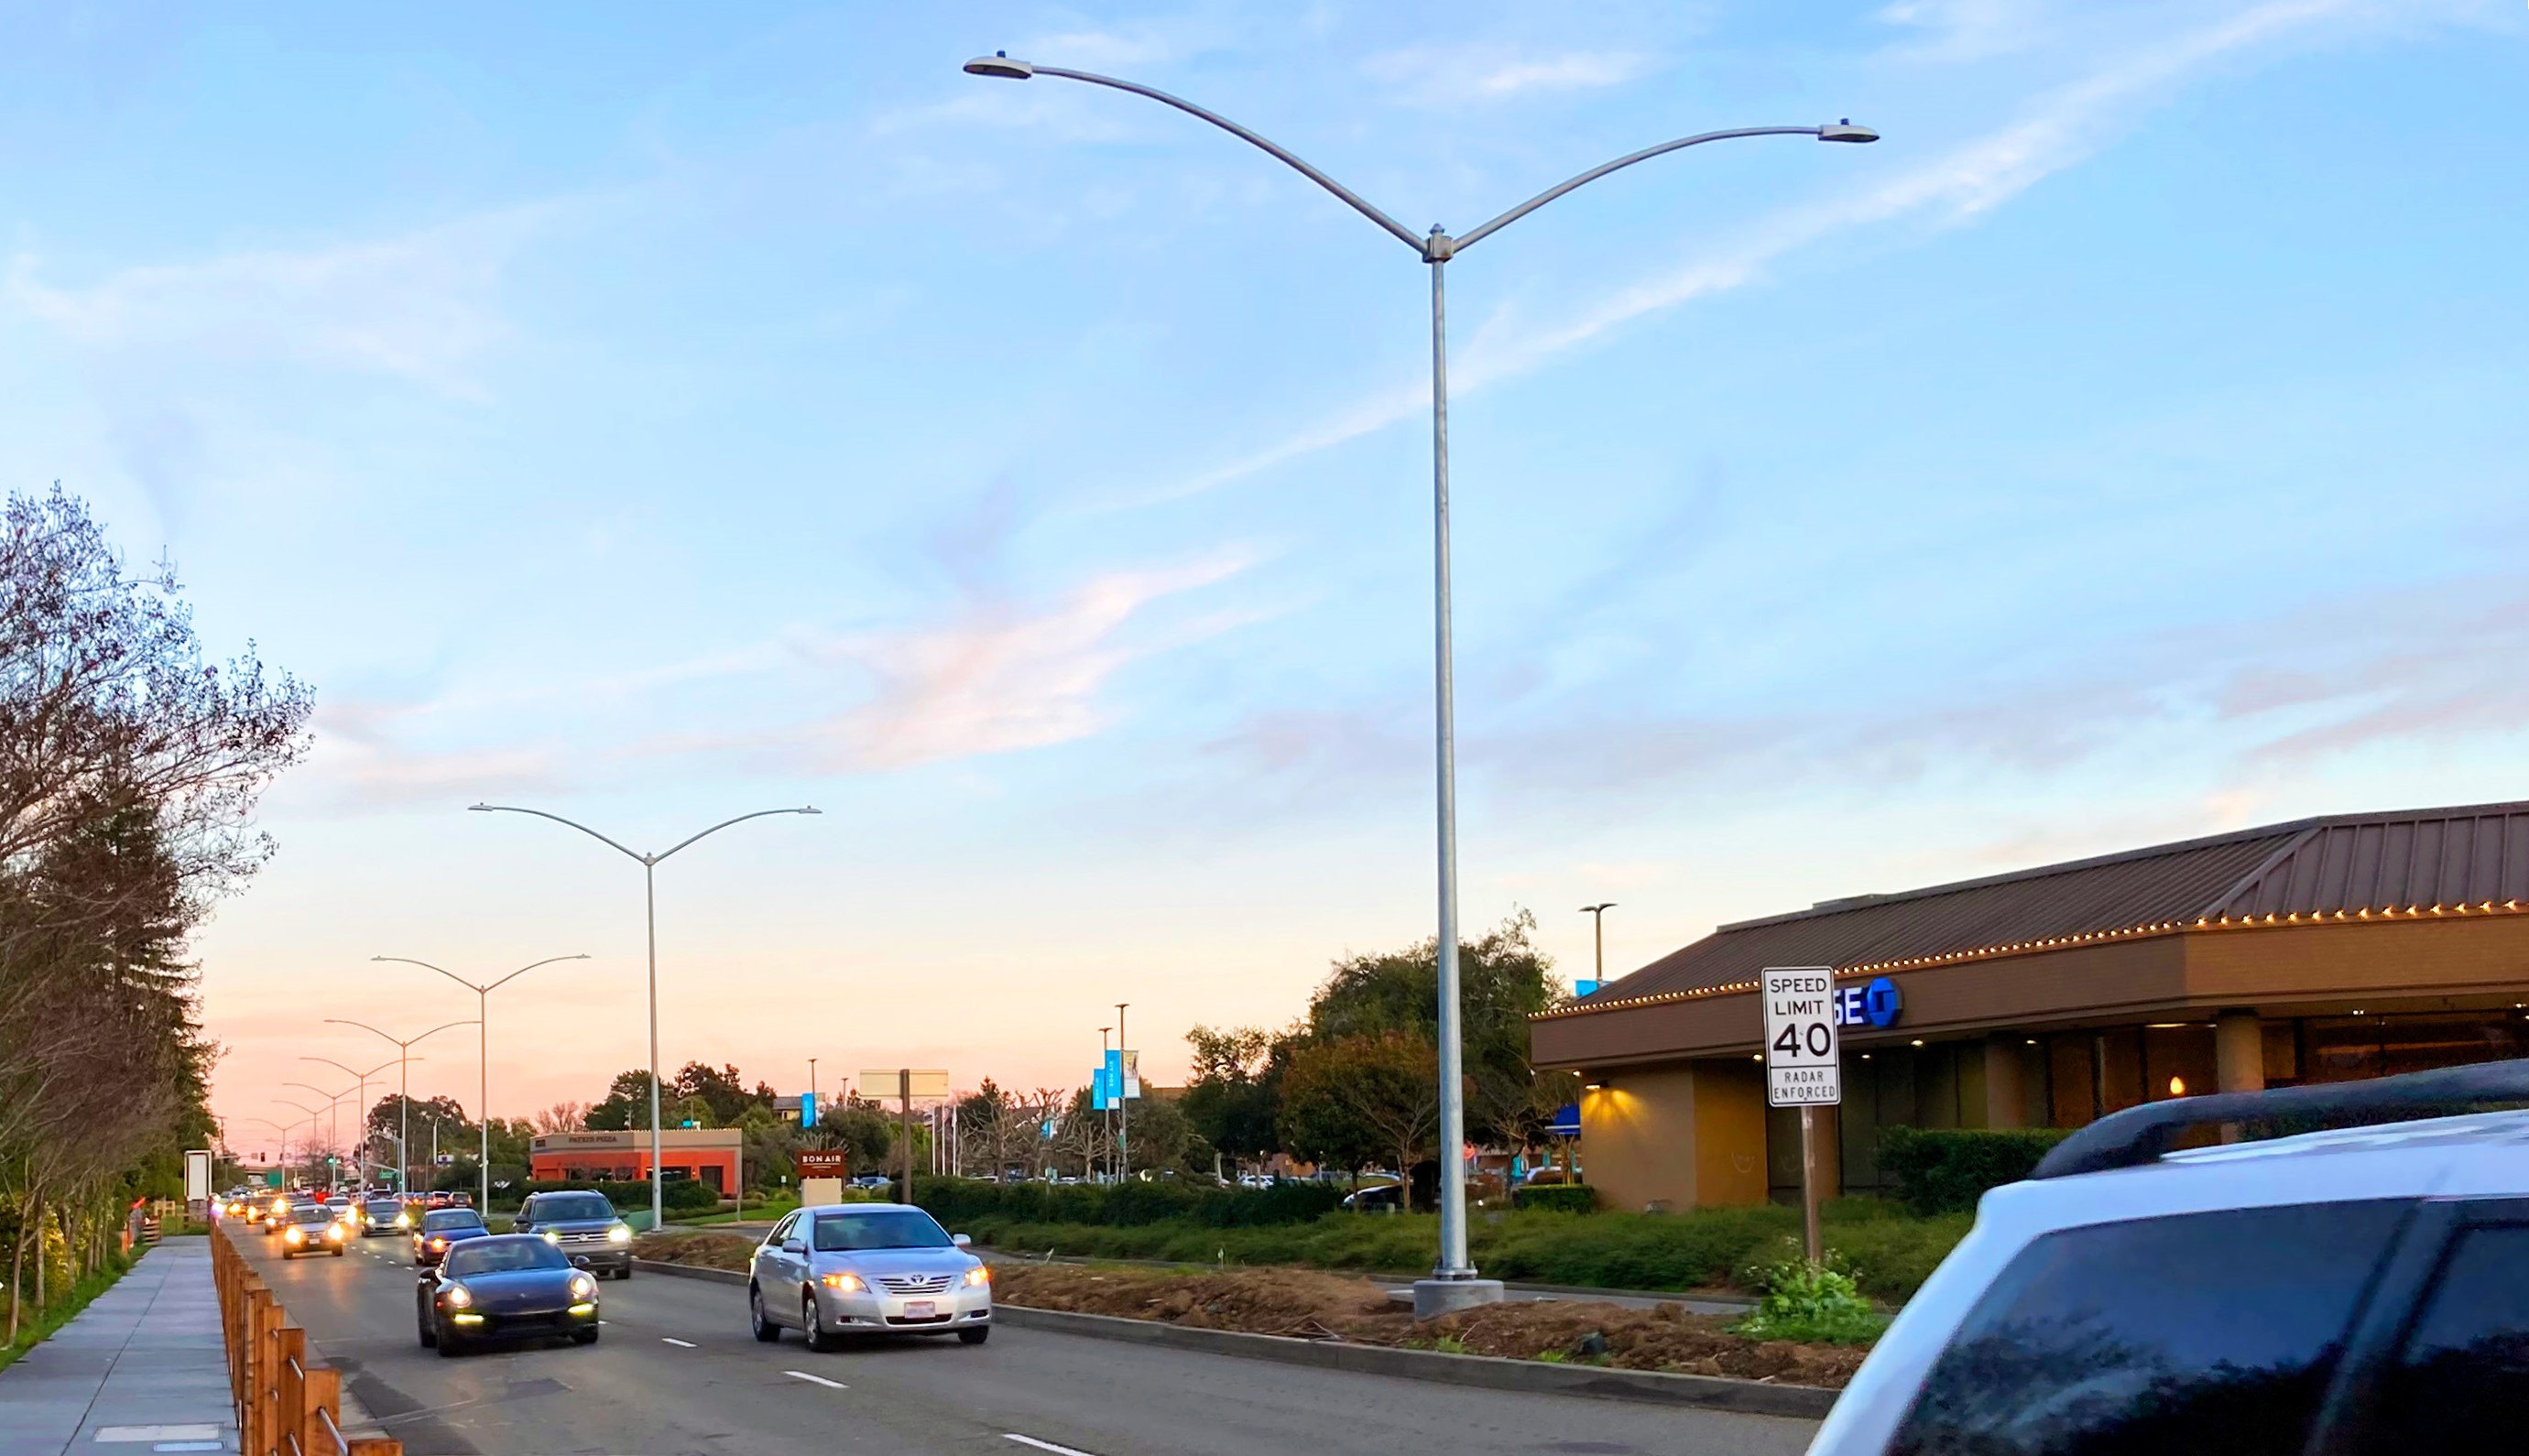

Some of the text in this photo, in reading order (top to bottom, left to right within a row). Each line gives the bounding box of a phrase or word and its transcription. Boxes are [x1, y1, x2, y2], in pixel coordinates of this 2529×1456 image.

[1770, 978, 1826, 993] SPEED
[1775, 1000, 1825, 1016] LIMIT
[1773, 1022, 1831, 1058] 40
[1784, 1071, 1824, 1082] RADAR
[1774, 1086, 1836, 1100] ENFORCED
[824, 1155, 842, 1163] AIR
